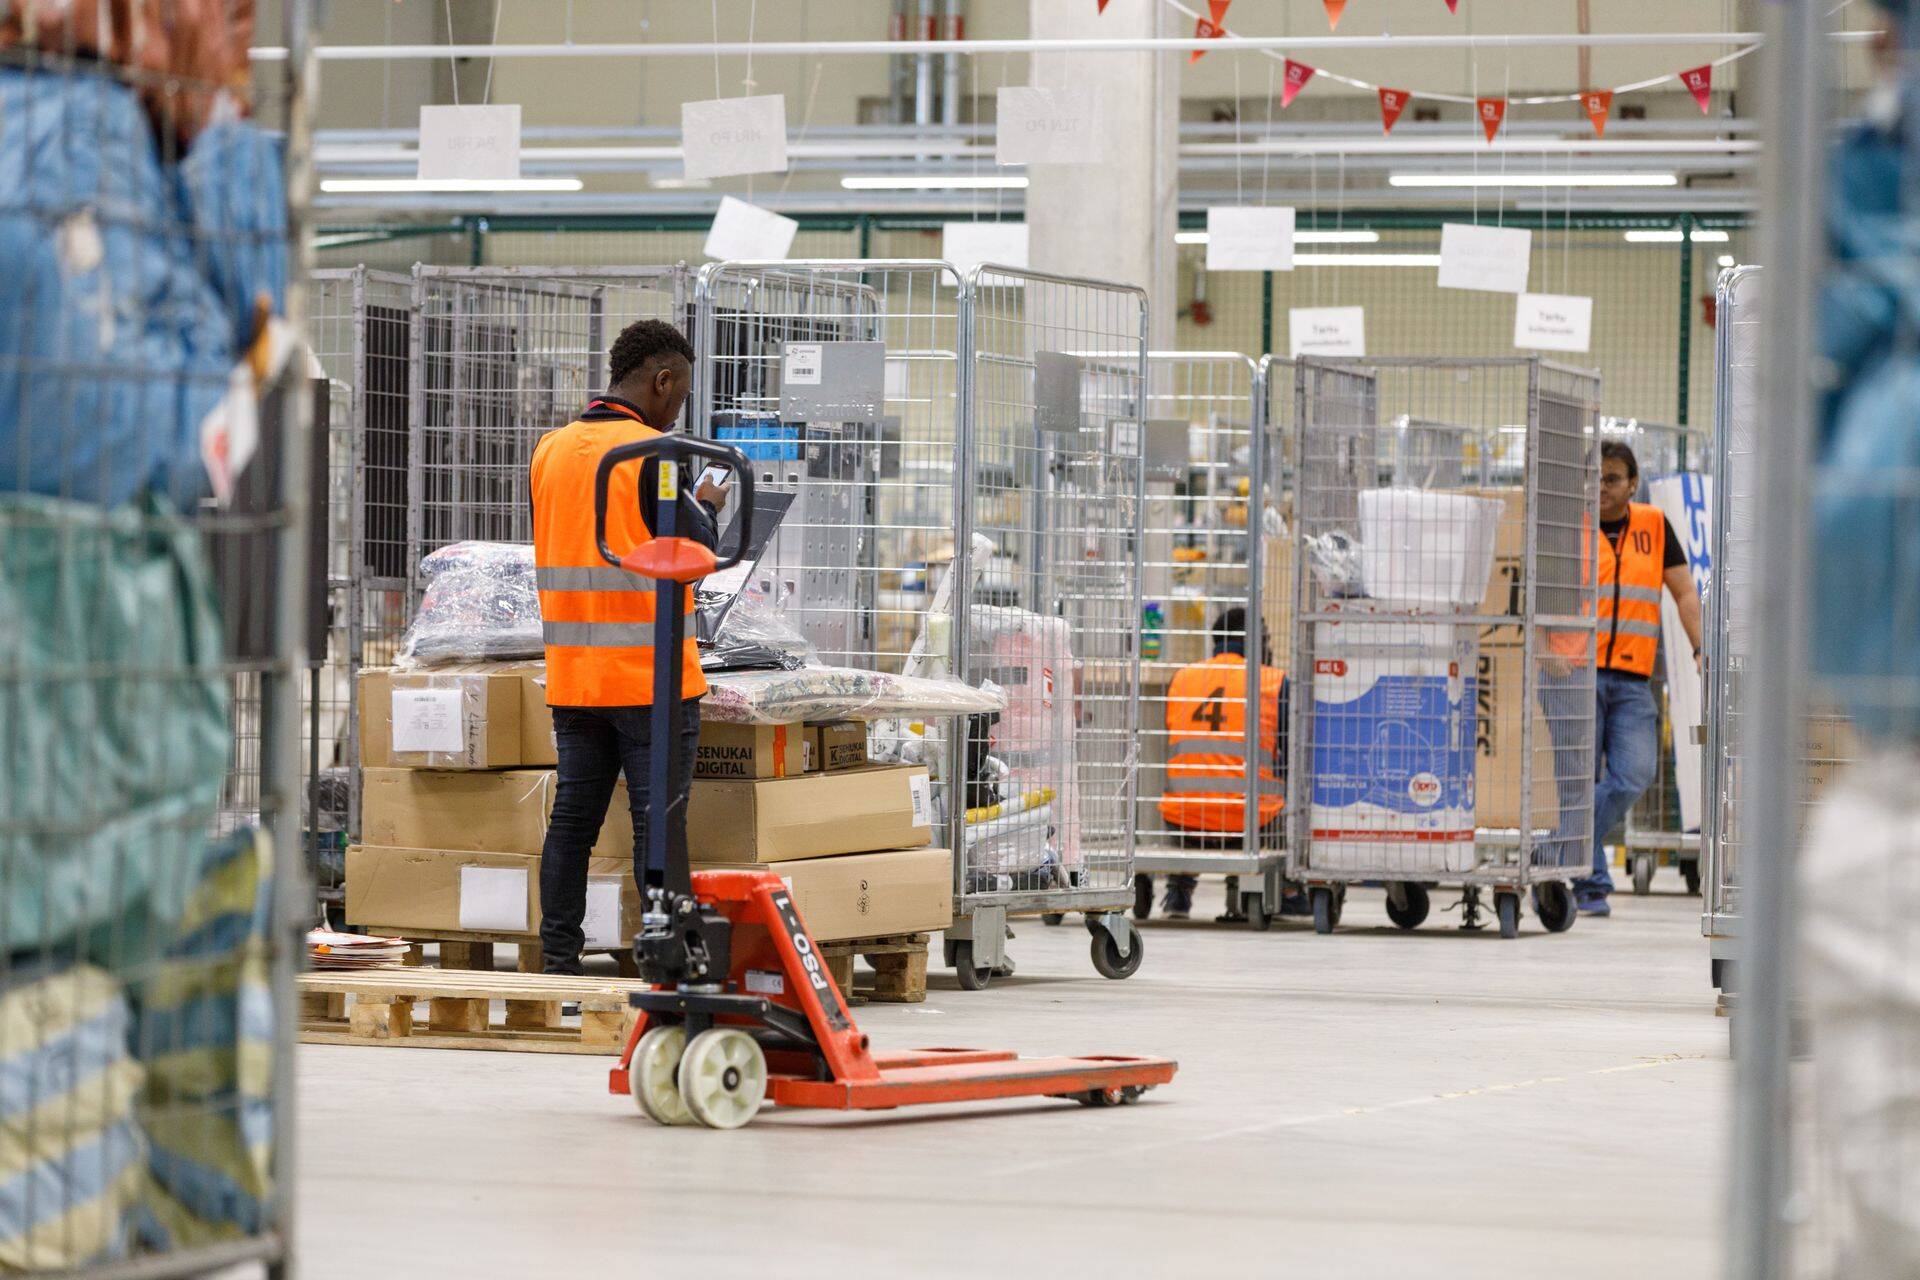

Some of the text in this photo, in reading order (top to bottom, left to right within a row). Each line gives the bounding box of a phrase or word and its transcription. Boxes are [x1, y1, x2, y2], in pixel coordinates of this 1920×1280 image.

[1630, 528, 1652, 555] 10
[1191, 686, 1229, 732] 4
[696, 746, 753, 760] SENUKAI
[695, 761, 747, 775] DIGITAL
[793, 932, 829, 990] PSO
